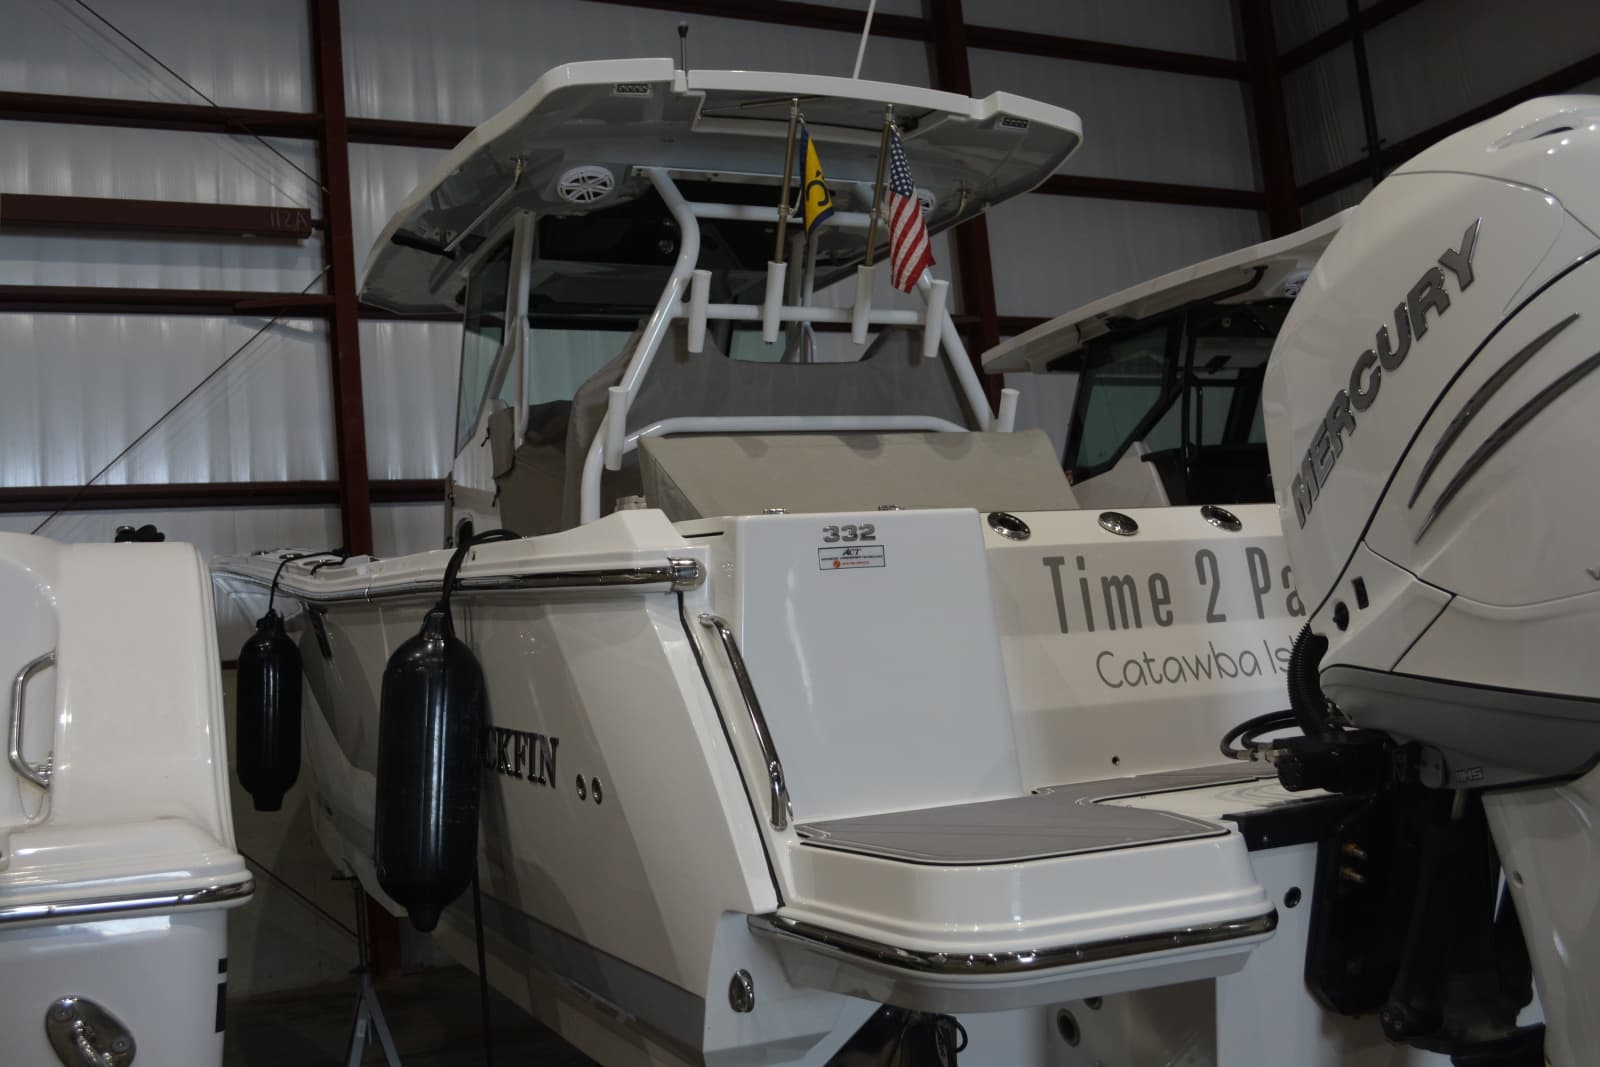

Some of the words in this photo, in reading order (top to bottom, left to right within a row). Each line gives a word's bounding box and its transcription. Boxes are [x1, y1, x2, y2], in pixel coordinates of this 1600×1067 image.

[1290, 217, 1482, 530] MERCURY
[822, 523, 876, 543] 332
[1042, 555, 1173, 633] Time
[1194, 548, 1226, 623] 2
[1096, 641, 1262, 688] Catawba
[1263, 634, 1295, 675] Is
